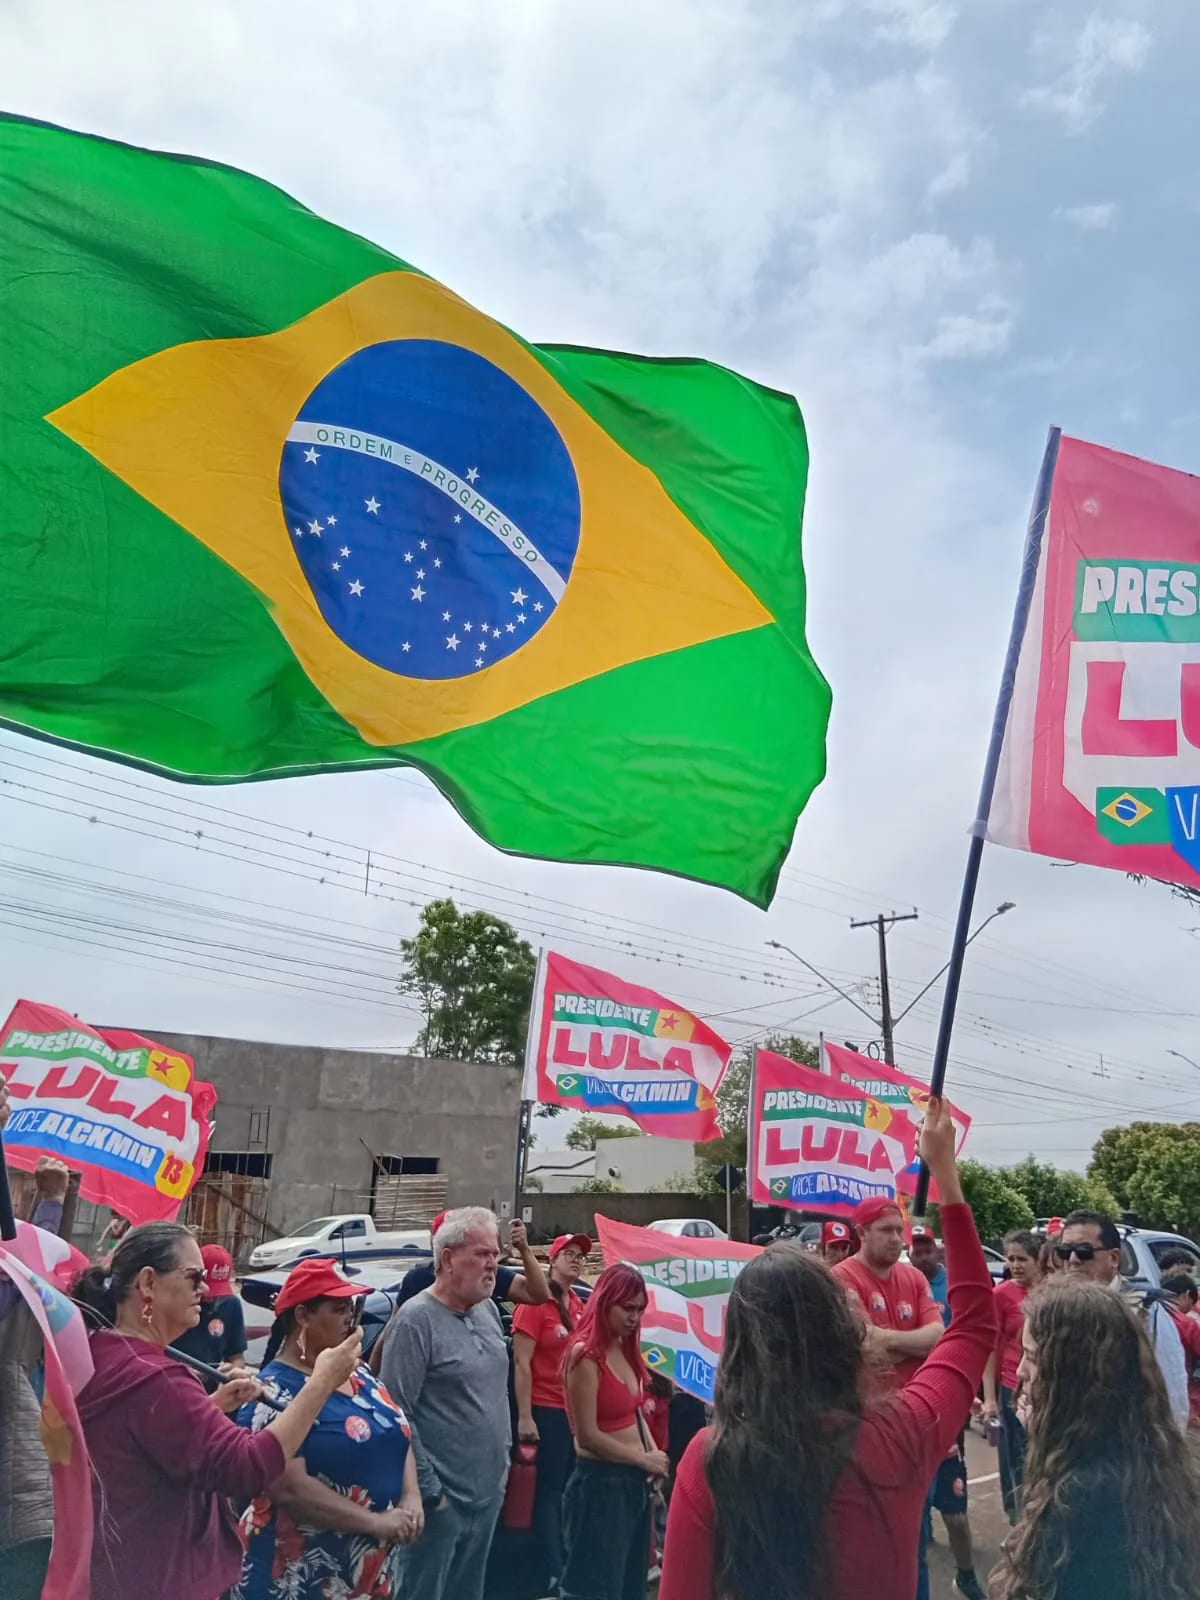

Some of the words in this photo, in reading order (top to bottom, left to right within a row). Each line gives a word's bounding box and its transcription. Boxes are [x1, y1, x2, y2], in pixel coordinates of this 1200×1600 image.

[317, 428, 393, 459] ORDEM
[420, 461, 538, 563] PROGRESSO
[1080, 566, 1200, 616] PRES
[555, 994, 651, 1027] PRESIDENTE
[6, 1031, 142, 1071] PRESIDENTE
[553, 1028, 696, 1079] LULA
[0, 1063, 187, 1142] LULA
[764, 1091, 863, 1116] PRESIDENTE
[5, 1110, 45, 1132] VICE
[38, 1112, 156, 1169] ALCKMIN
[765, 1125, 894, 1174] LULA
[161, 1154, 184, 1185] 13
[792, 1175, 816, 1197] VICE
[680, 1353, 712, 1390] VICE
